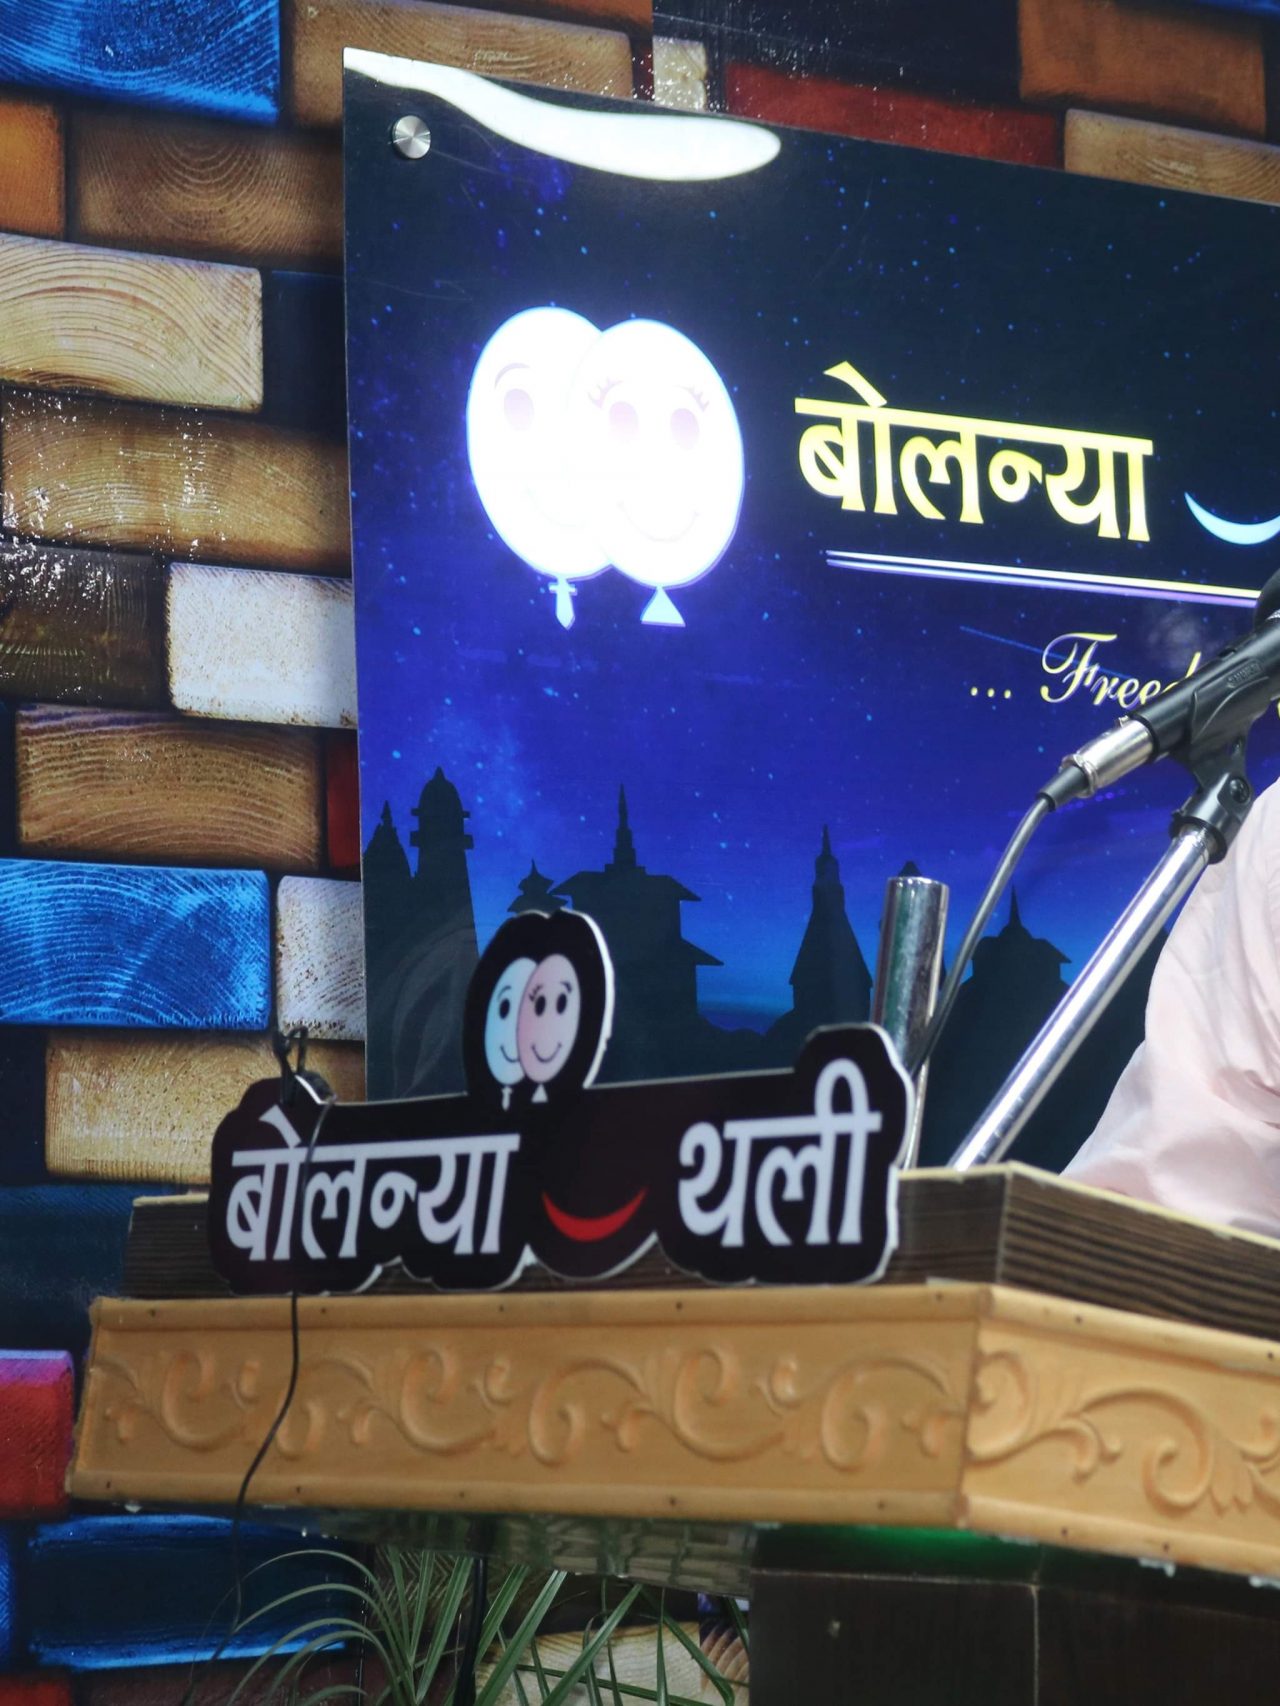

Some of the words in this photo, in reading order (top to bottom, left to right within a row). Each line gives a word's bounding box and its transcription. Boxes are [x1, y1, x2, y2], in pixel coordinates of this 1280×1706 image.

[795, 361, 1153, 542] बोलन्या
[1040, 632, 1201, 709] Free
[226, 1105, 520, 1262] बोलन्या
[679, 1058, 882, 1247] थली
